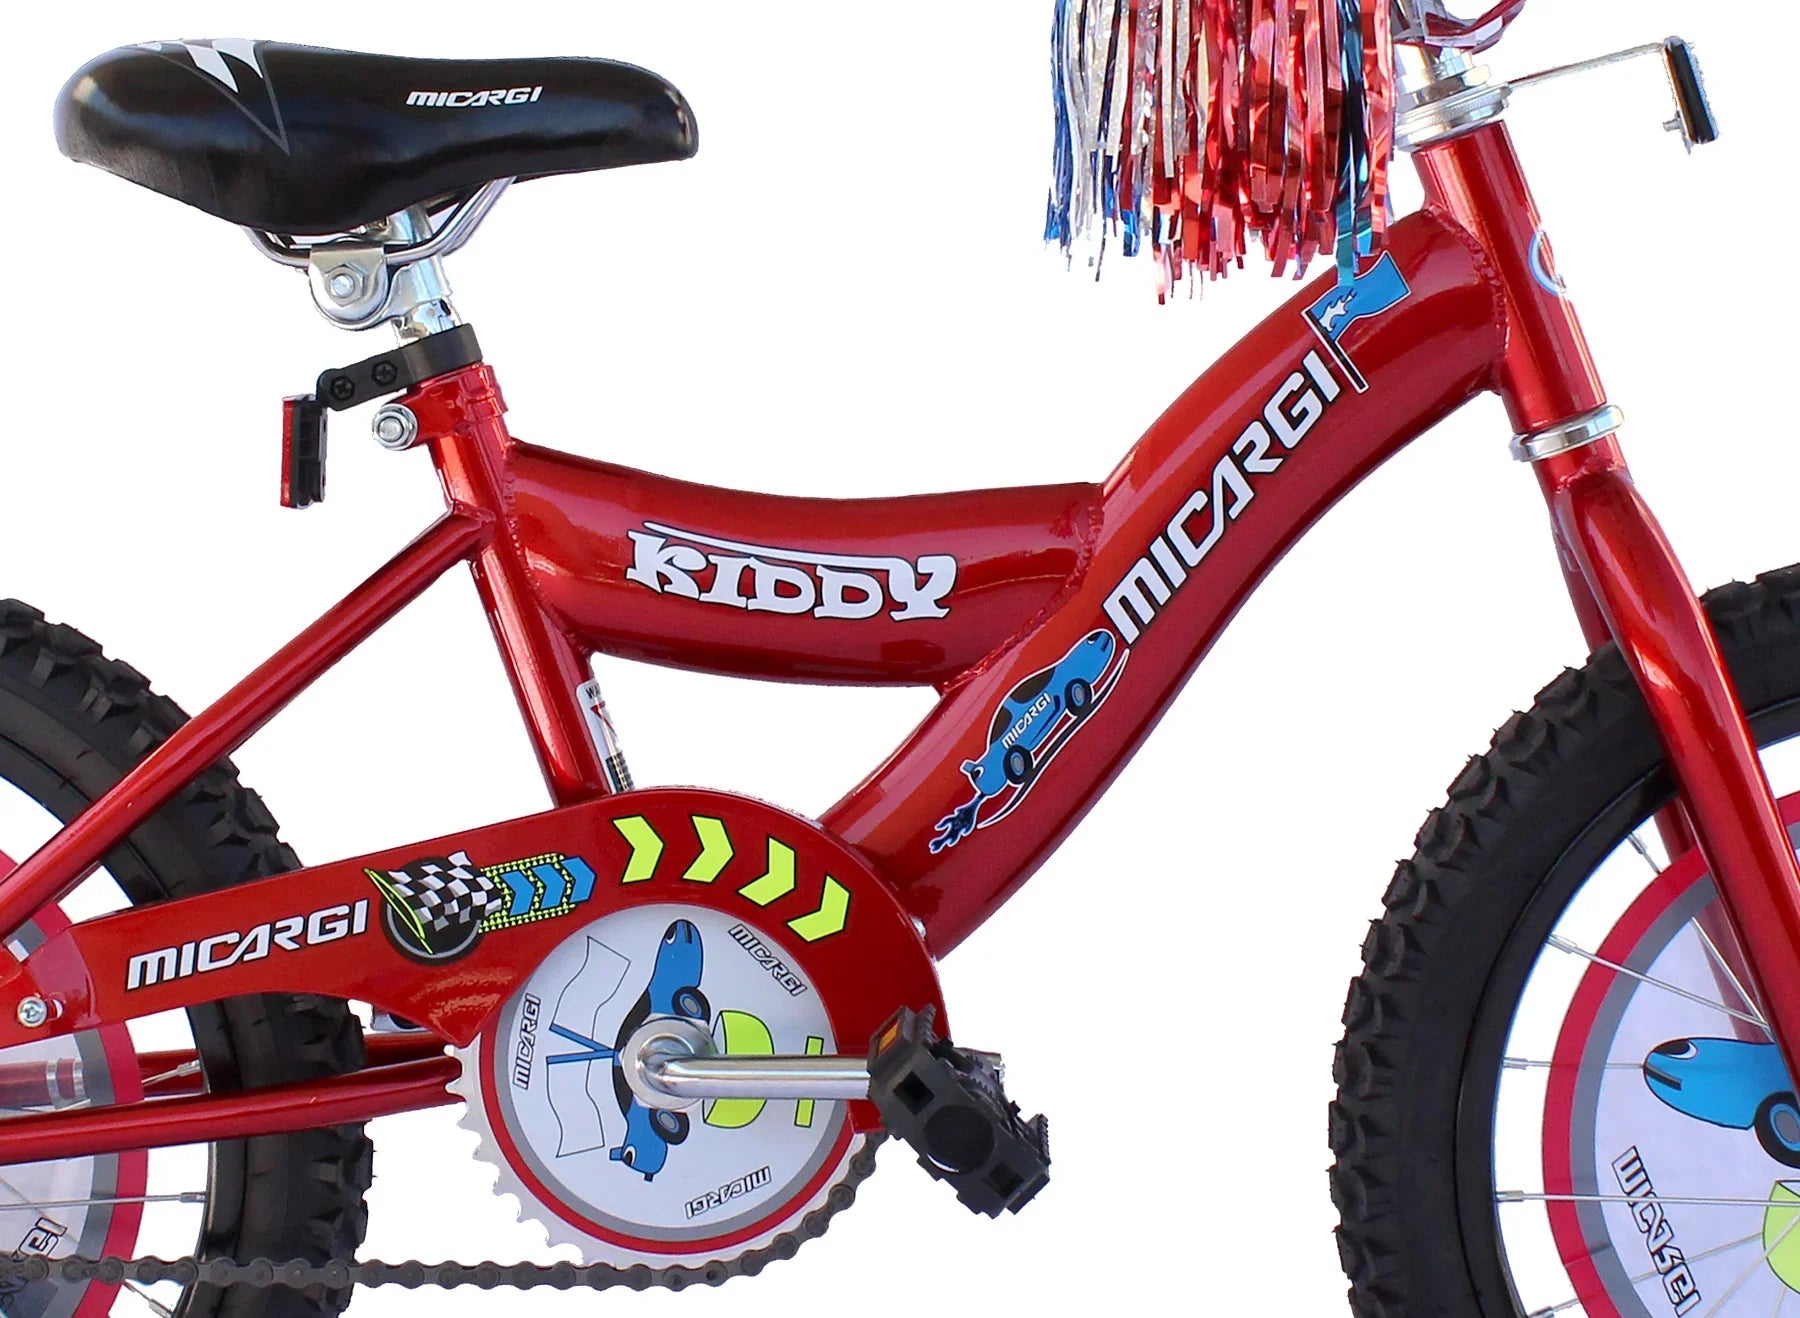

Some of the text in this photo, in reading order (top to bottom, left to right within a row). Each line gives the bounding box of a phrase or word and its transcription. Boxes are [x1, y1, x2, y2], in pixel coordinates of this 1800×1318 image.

[406, 86, 543, 107] MICARGI
[1102, 350, 1340, 645] MICARGI
[626, 522, 957, 621] KIDDY
[1001, 692, 1051, 749] MICARGI
[126, 899, 370, 991] MICARGI
[728, 924, 808, 997] MICARGI
[512, 993, 541, 1090] MICARGI
[685, 1166, 772, 1220] MICARGI
